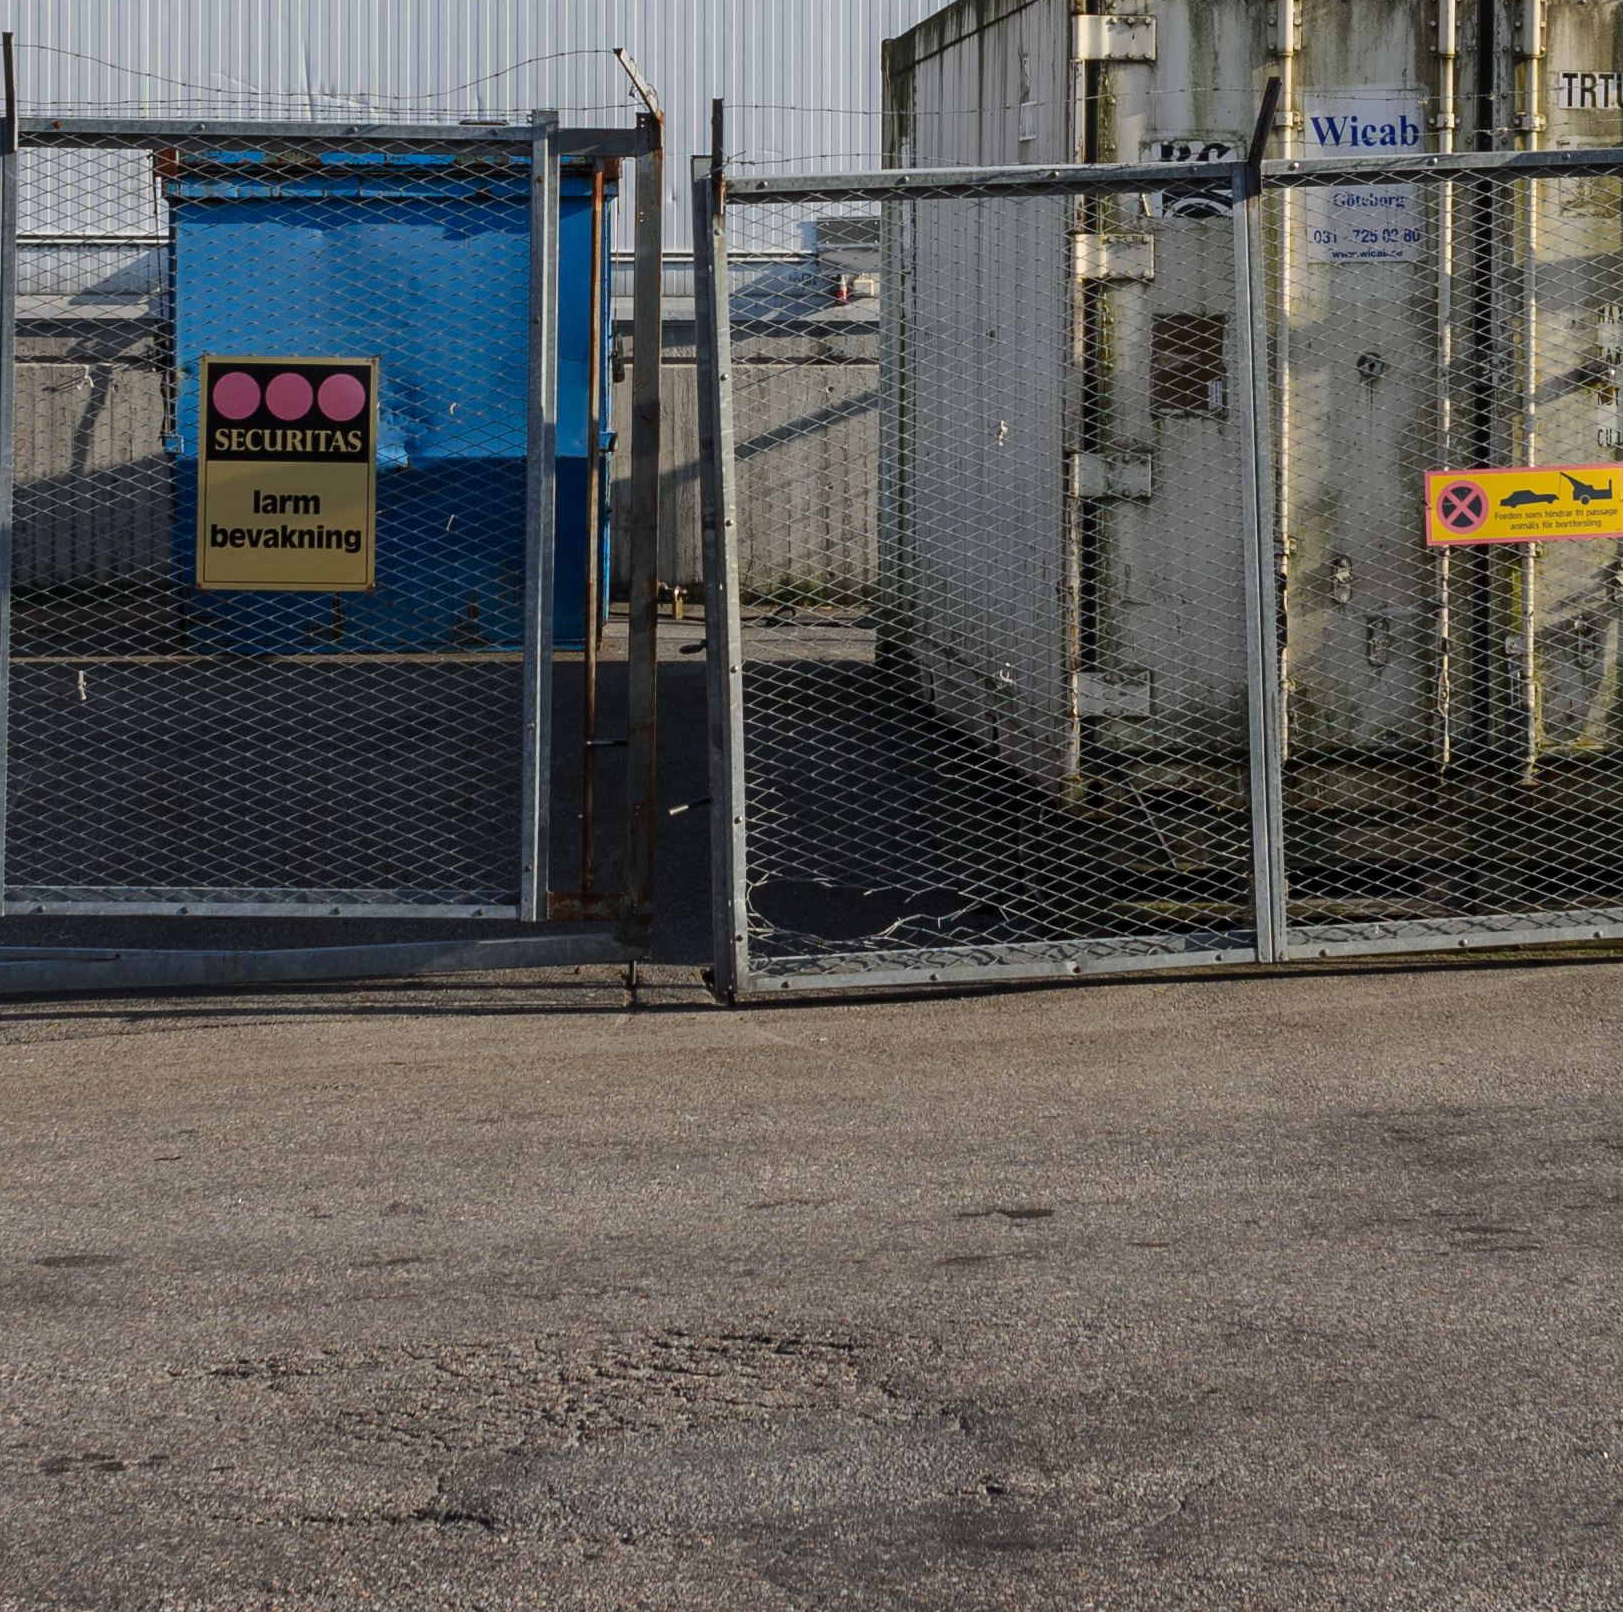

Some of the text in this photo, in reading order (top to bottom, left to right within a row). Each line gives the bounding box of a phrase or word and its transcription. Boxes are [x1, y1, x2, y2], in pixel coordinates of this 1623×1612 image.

[1309, 115, 1420, 148] Wicab
[1333, 192, 1406, 210] Göteborg
[1313, 229, 1338, 244] 031
[1352, 228, 1379, 244] 725
[1382, 228, 1399, 244] 02
[1403, 227, 1421, 243] 80
[1597, 387, 1621, 406] NT
[214, 428, 362, 453] SECURITAS
[253, 489, 321, 515] larm
[1494, 507, 1618, 521] Fordon som hindrar fri passage
[1510, 518, 1602, 530] anmäls för bortforsling
[210, 523, 362, 554] bevakning
